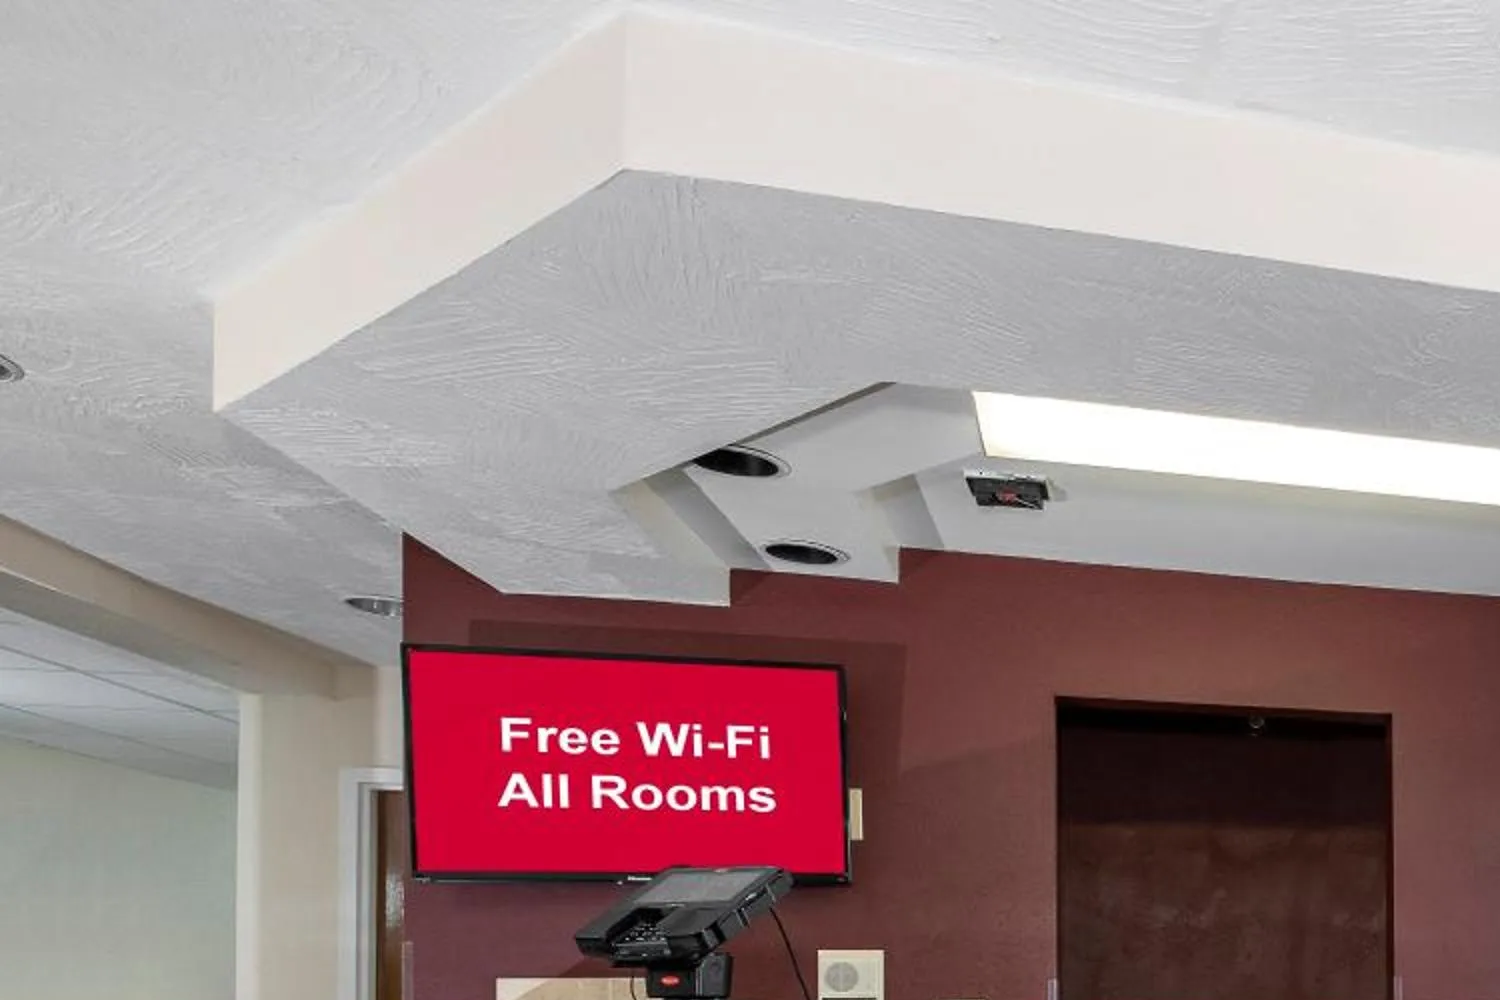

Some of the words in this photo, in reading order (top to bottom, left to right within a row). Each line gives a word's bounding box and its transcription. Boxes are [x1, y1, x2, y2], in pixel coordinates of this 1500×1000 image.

[499, 716, 621, 756] Free
[635, 721, 771, 760] Wi-Fi
[497, 772, 571, 810] All
[590, 774, 778, 813] Rooms
